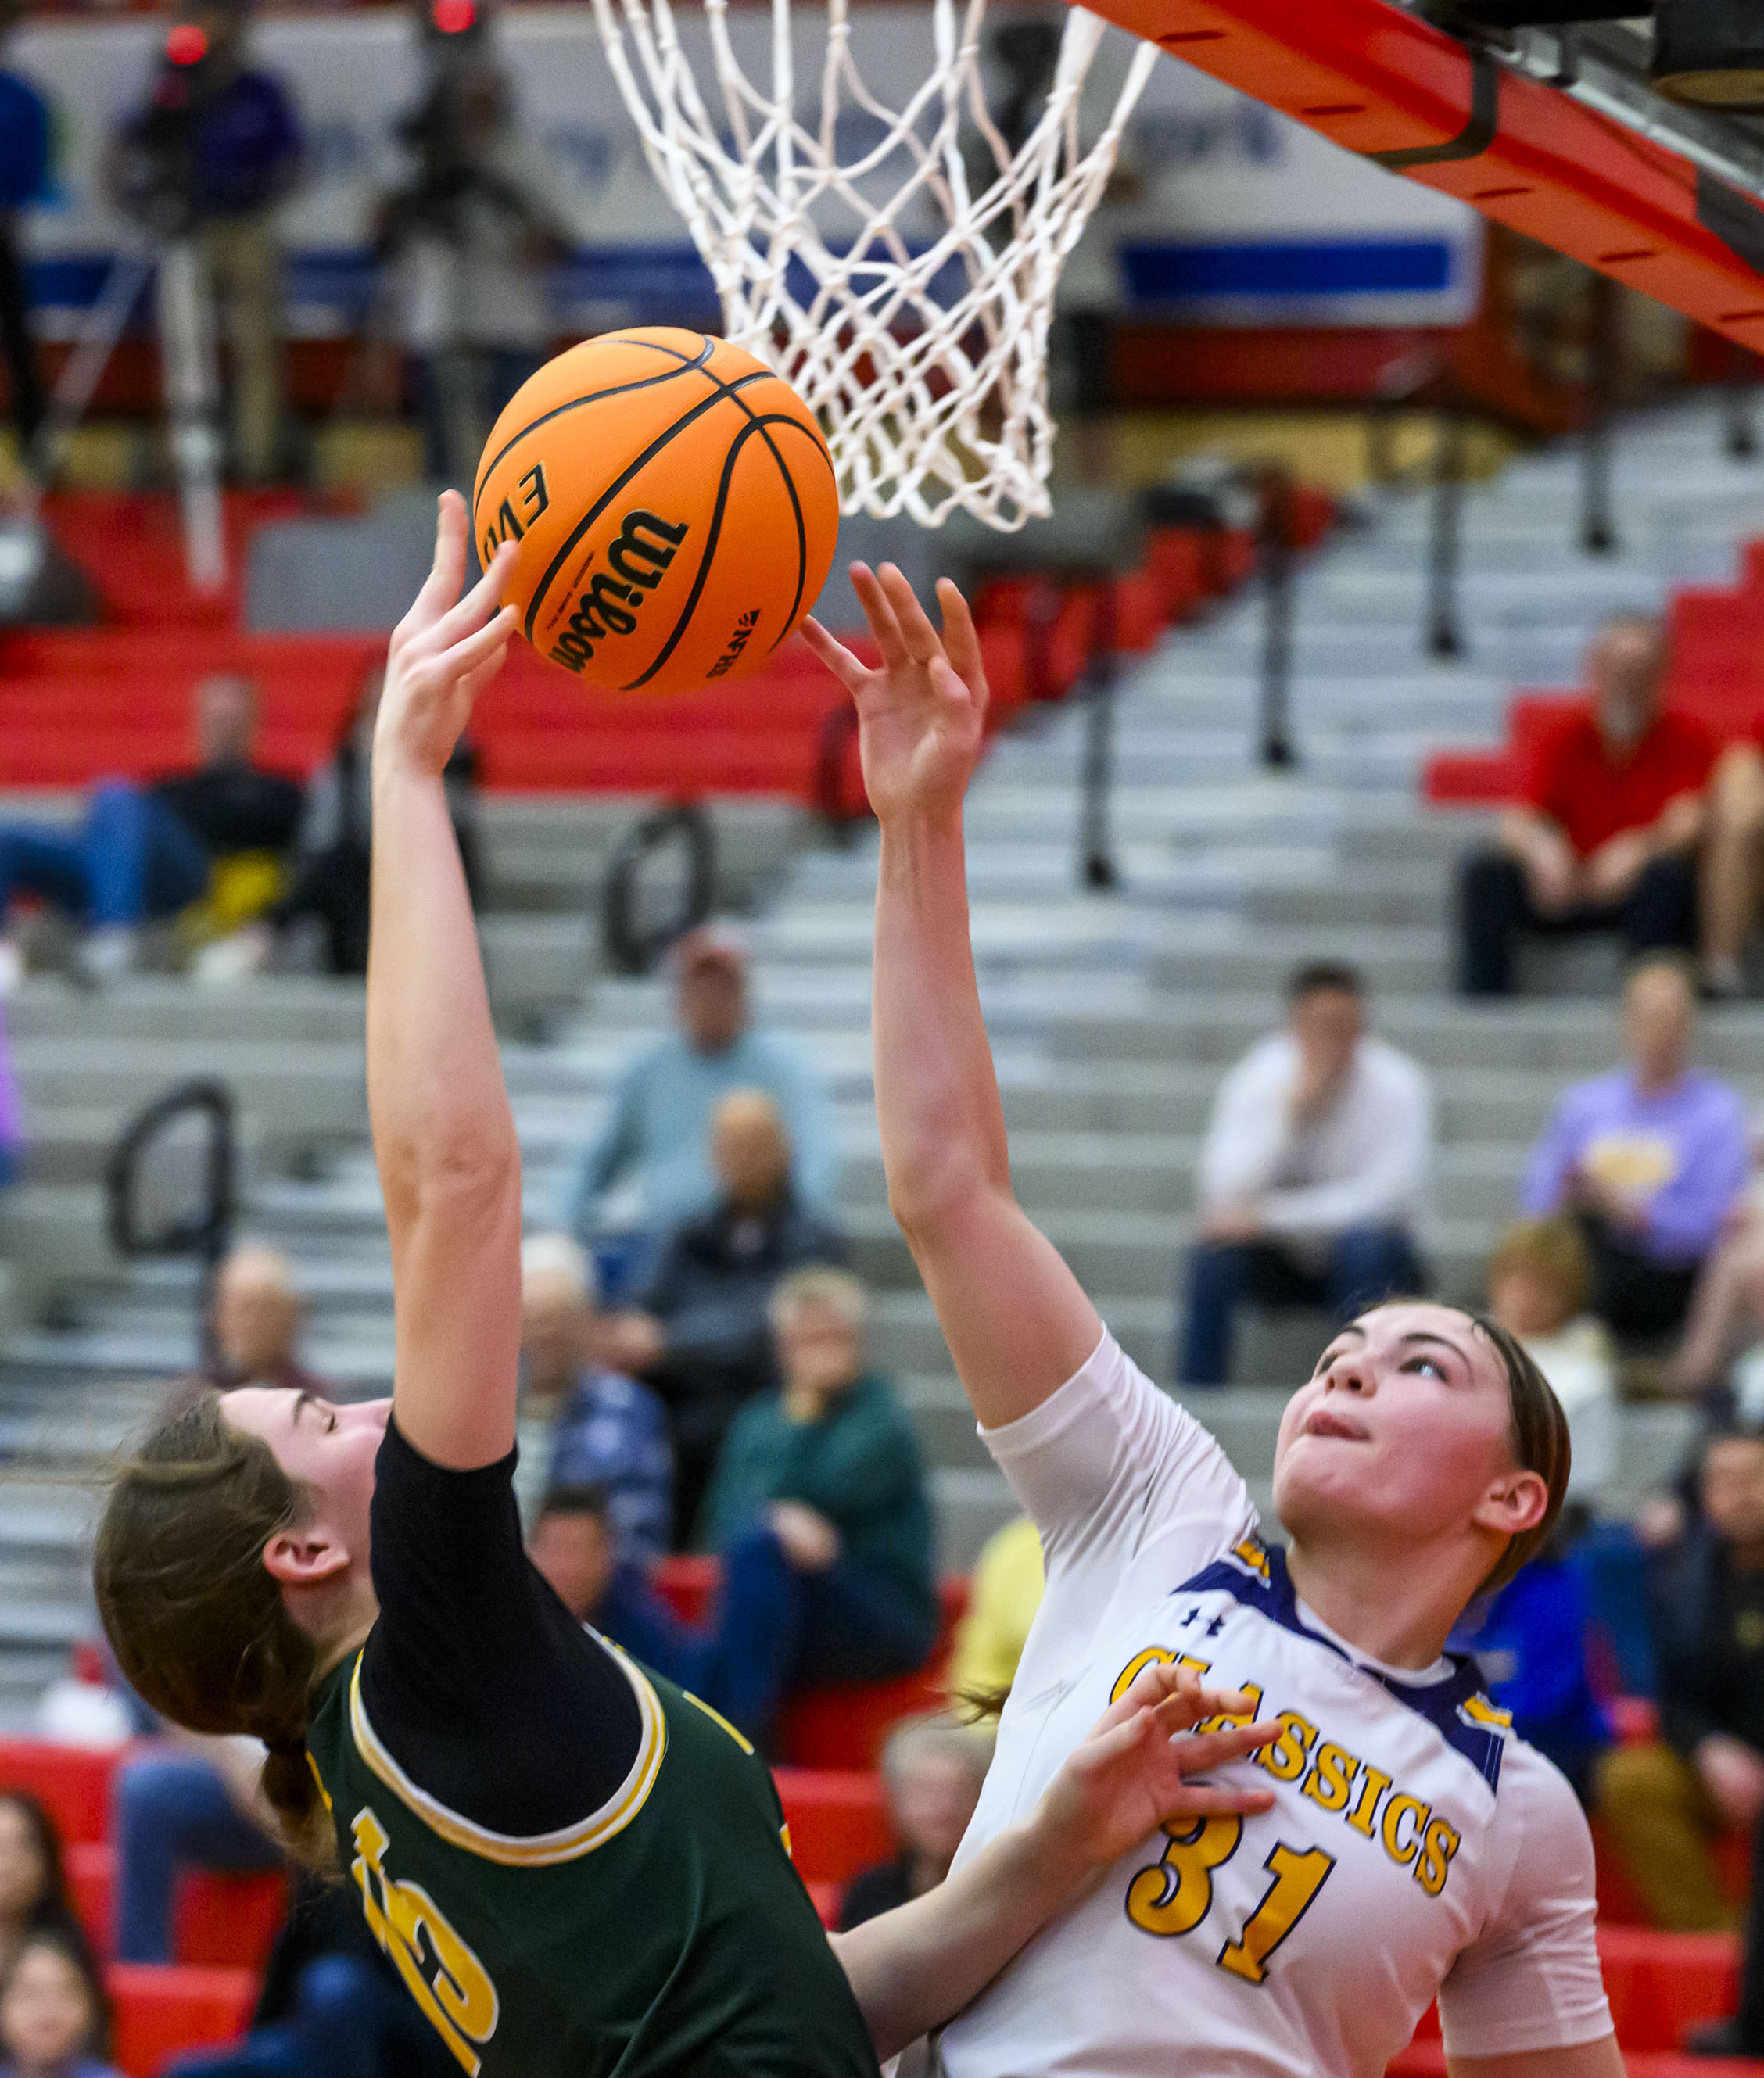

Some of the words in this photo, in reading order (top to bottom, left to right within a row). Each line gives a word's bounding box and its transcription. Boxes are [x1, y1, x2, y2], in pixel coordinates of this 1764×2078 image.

[548, 509, 689, 674] Wilson
[1110, 1646, 1461, 1897] CASSICS
[1125, 1782, 1337, 1983] 31
